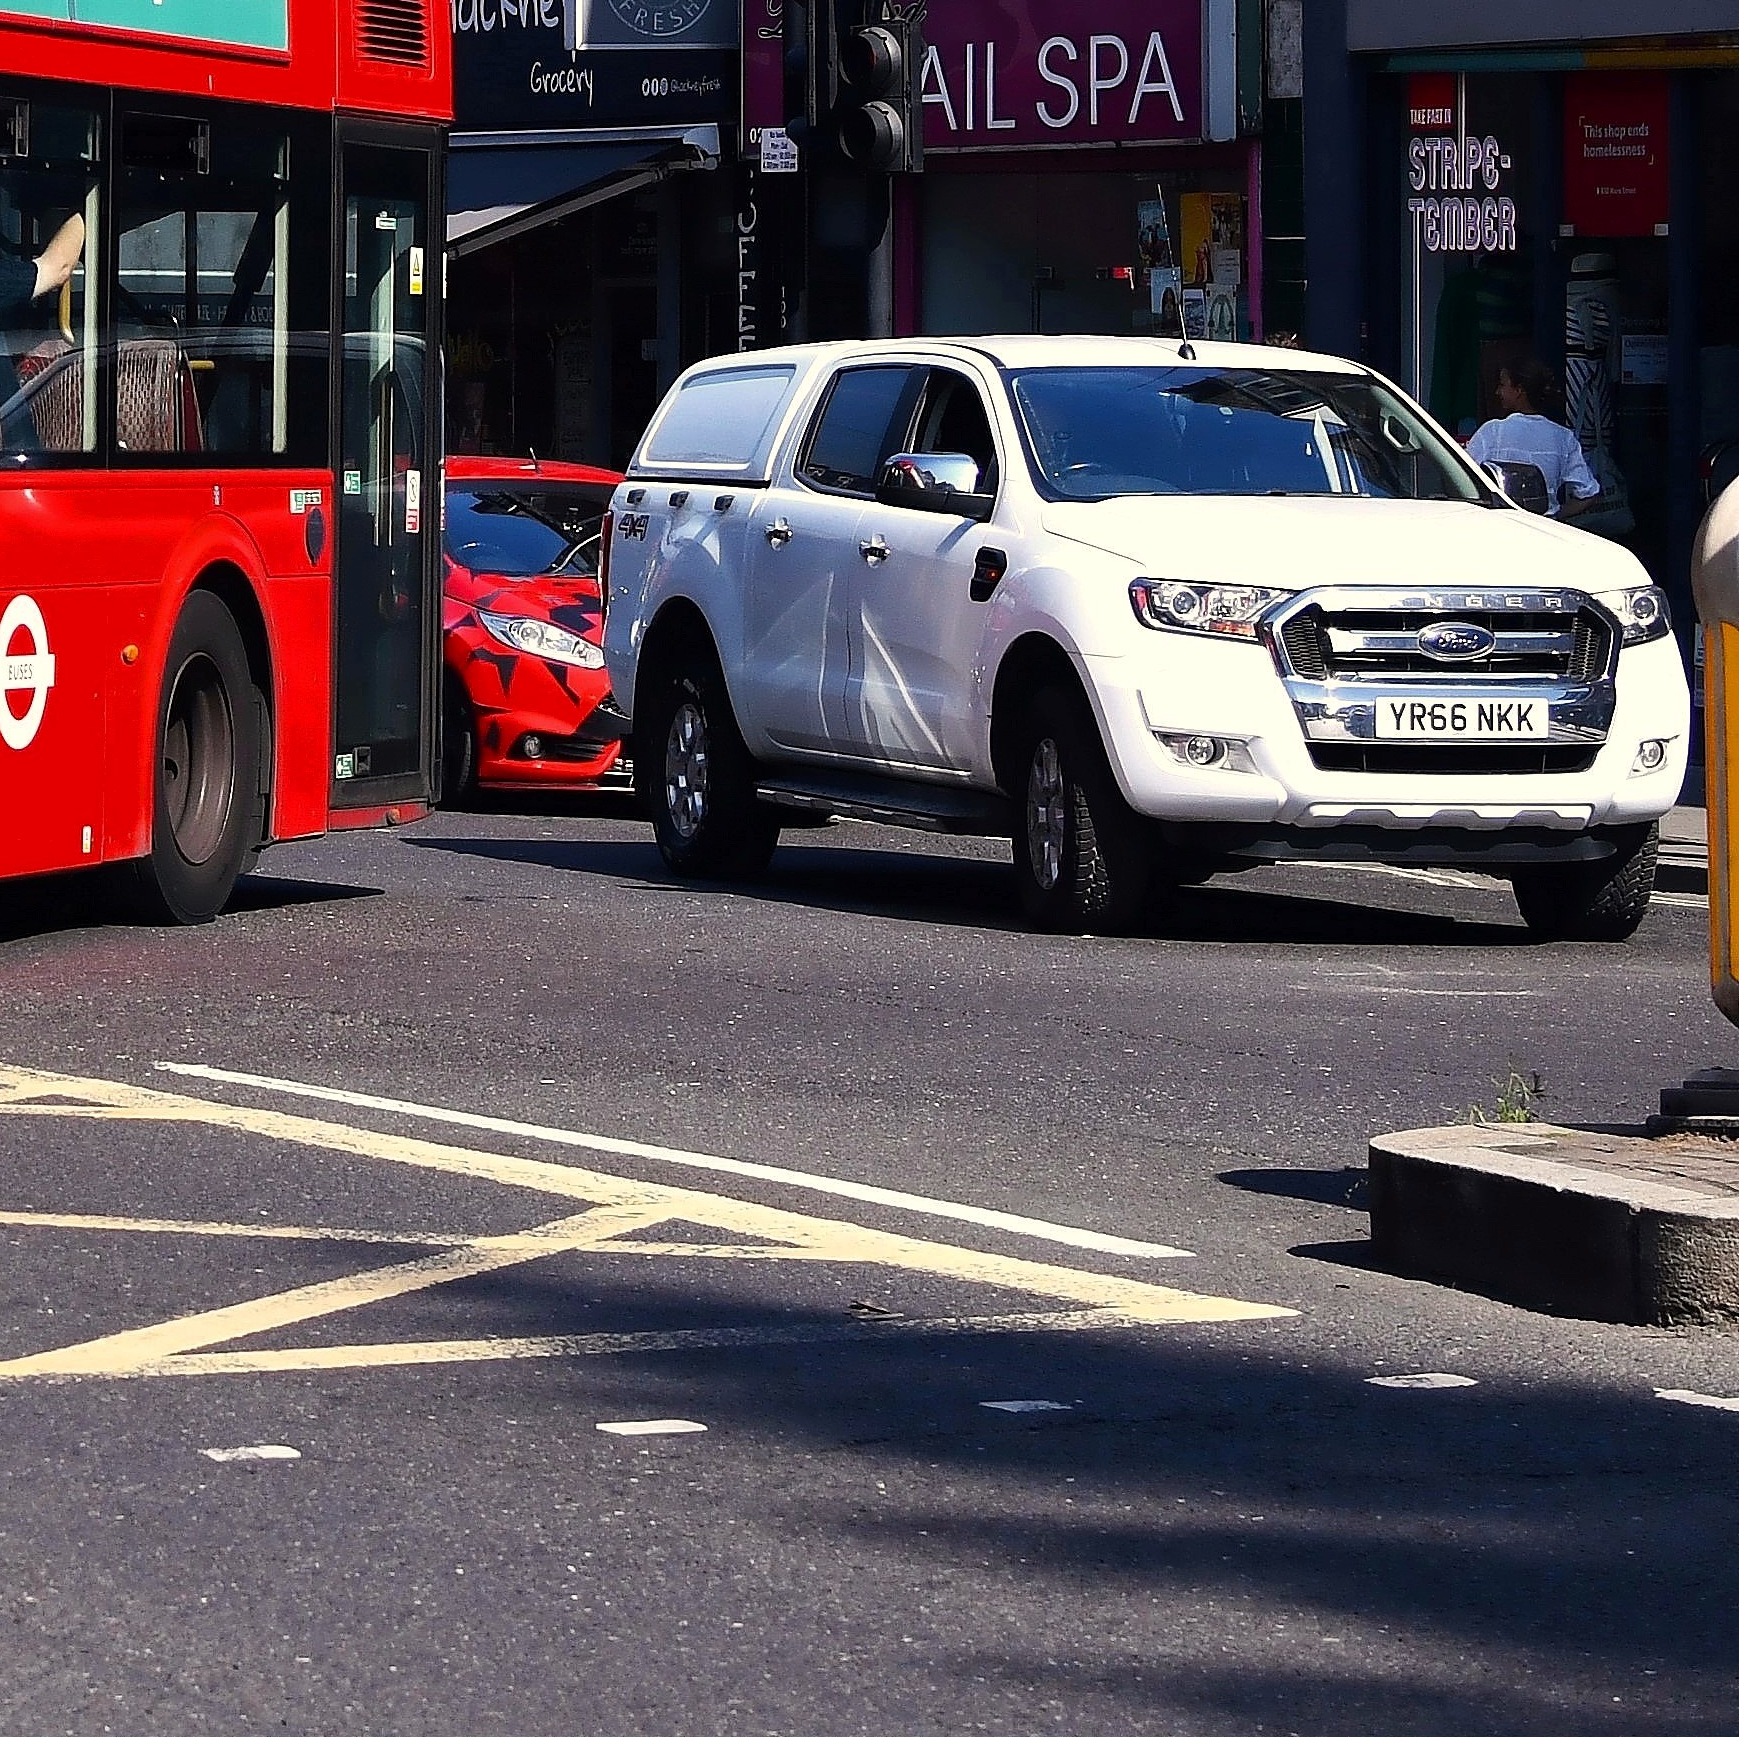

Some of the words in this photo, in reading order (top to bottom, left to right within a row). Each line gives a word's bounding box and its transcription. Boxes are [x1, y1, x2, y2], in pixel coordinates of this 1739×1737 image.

[530, 61, 593, 107] Grocery
[920, 41, 1017, 131] AIL
[1035, 30, 1185, 128] SPA
[1583, 124, 1603, 139] This
[1604, 123, 1627, 141] shop
[1627, 121, 1649, 138] ends
[1583, 143, 1646, 158] homelessness
[1407, 195, 1517, 253] TEMBER
[8, 663, 33, 681] BUSES
[1390, 702, 1468, 732] YR66
[1477, 702, 1535, 733] NKK
